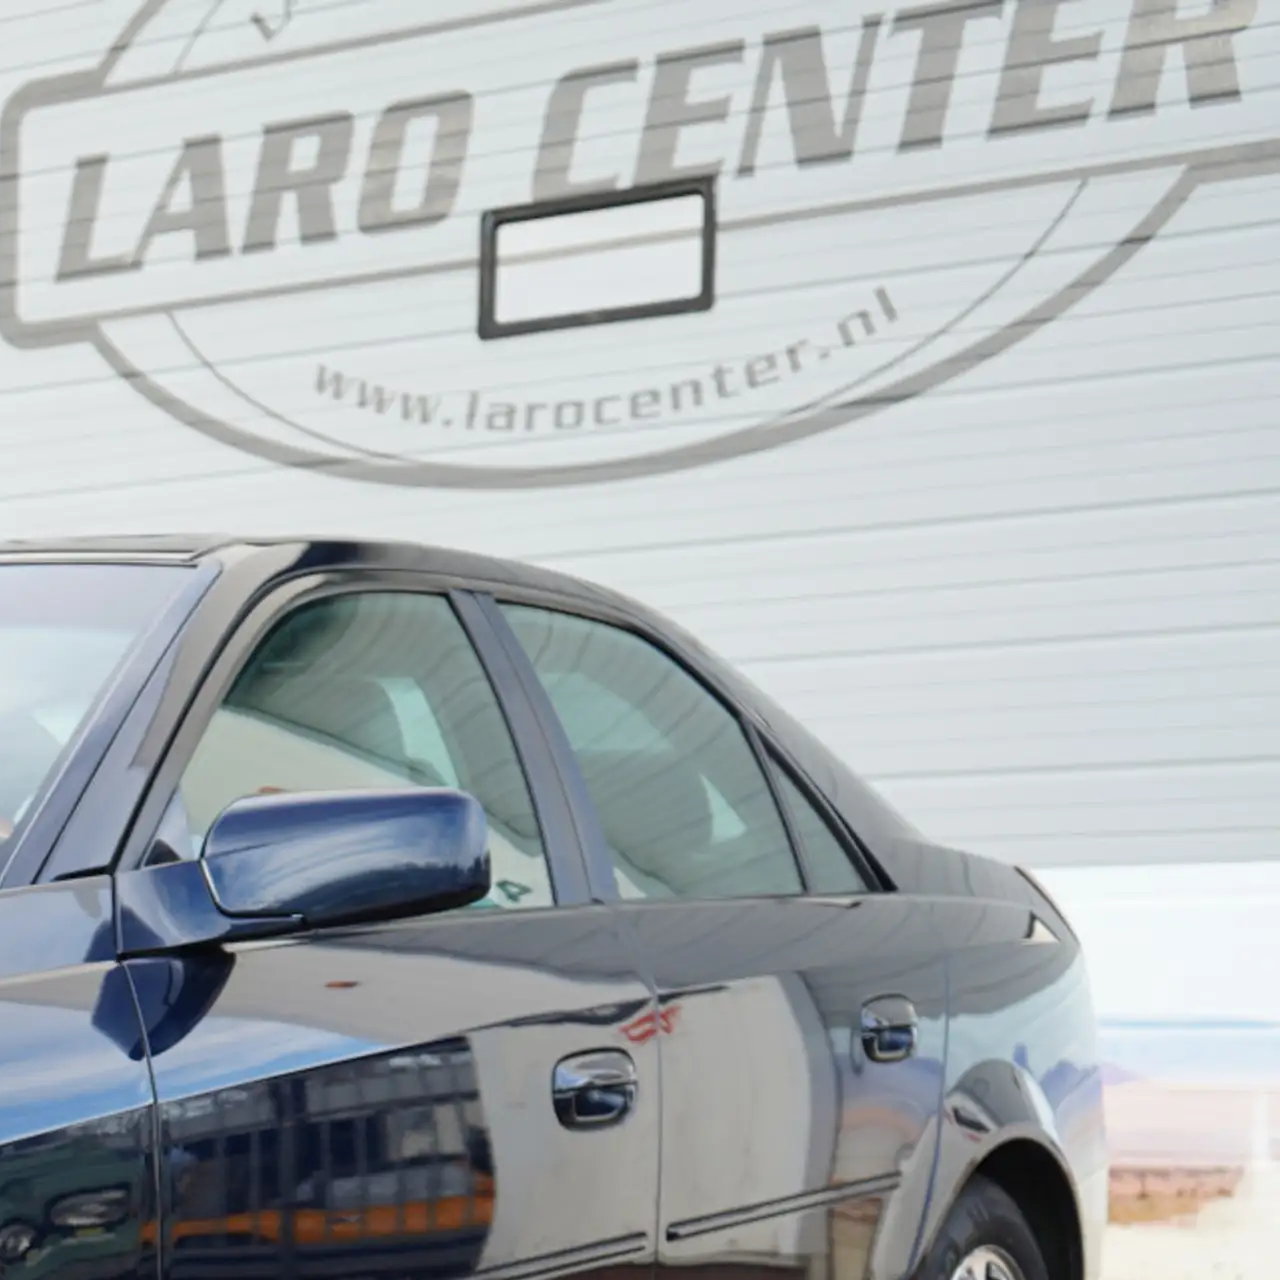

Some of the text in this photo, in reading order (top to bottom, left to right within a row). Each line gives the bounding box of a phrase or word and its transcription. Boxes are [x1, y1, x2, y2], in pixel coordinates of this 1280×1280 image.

[55, 0, 1259, 282] LARO CENTER
[313, 285, 900, 434] www.larocenter.nl
